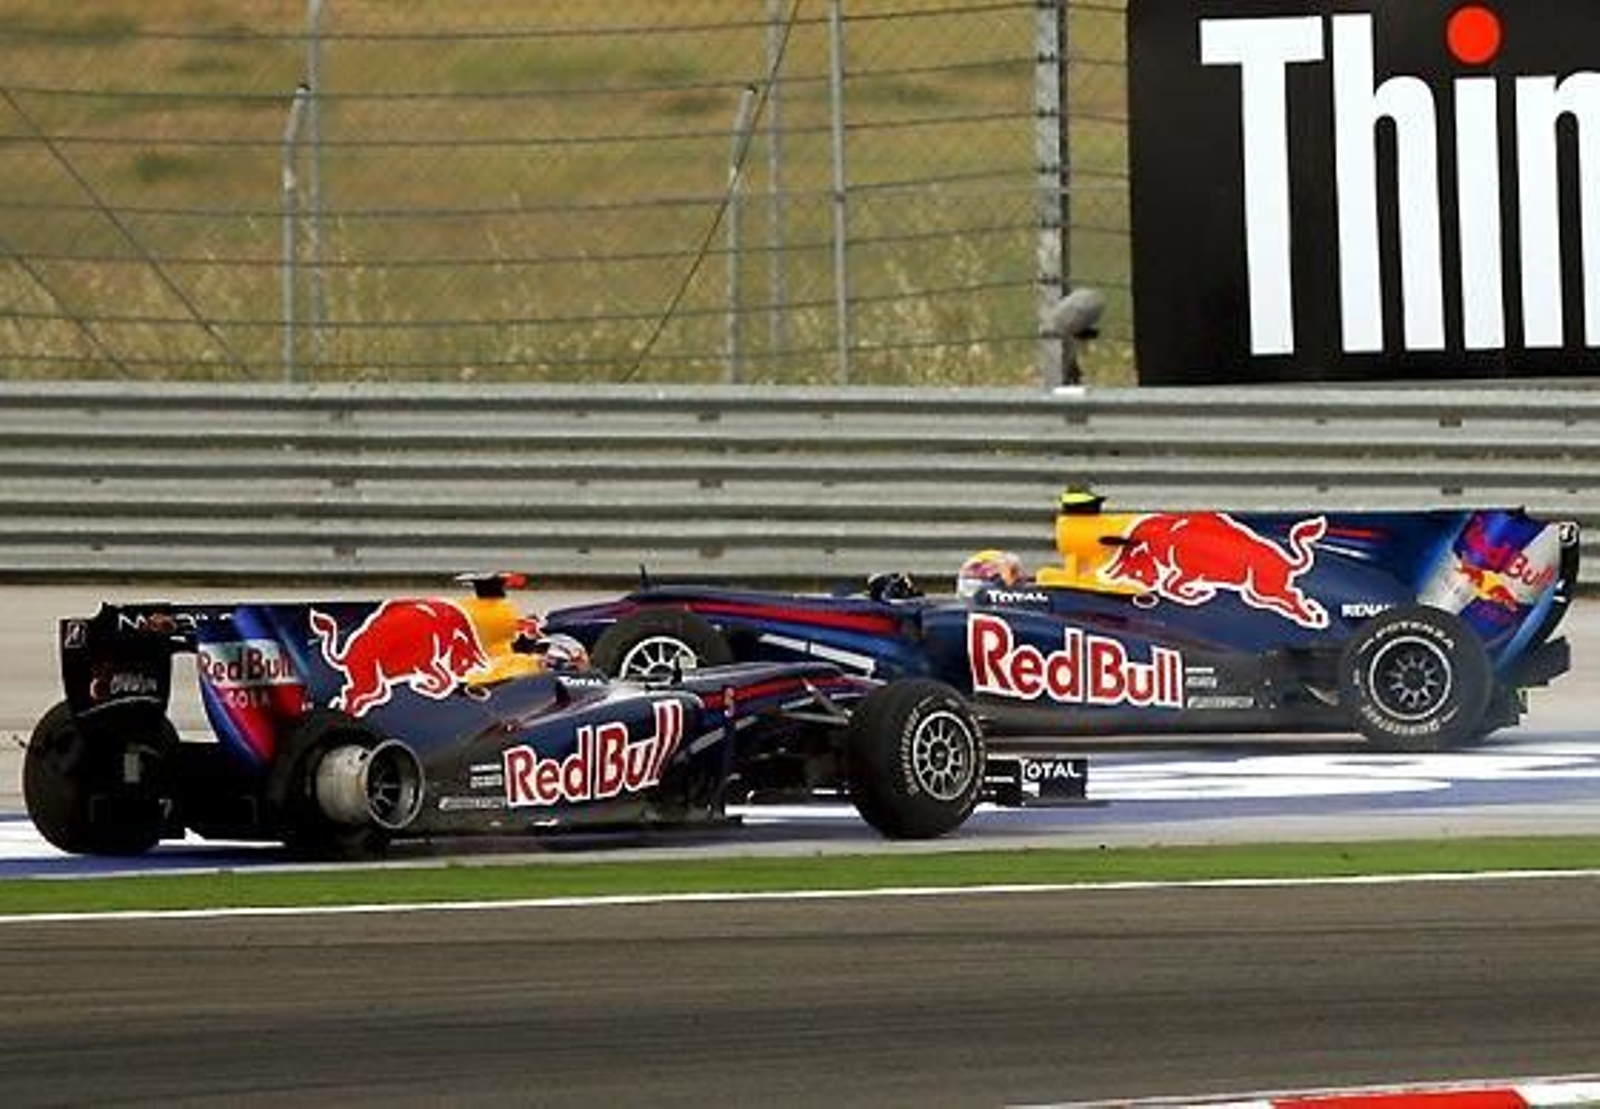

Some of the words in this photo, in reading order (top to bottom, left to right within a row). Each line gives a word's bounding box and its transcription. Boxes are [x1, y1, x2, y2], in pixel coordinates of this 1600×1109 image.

[967, 613, 1083, 701] Red
[1086, 635, 1183, 708] Bull
[503, 725, 592, 808] Red
[594, 699, 683, 799] Bull
[1020, 758, 1083, 783] TOTAL
